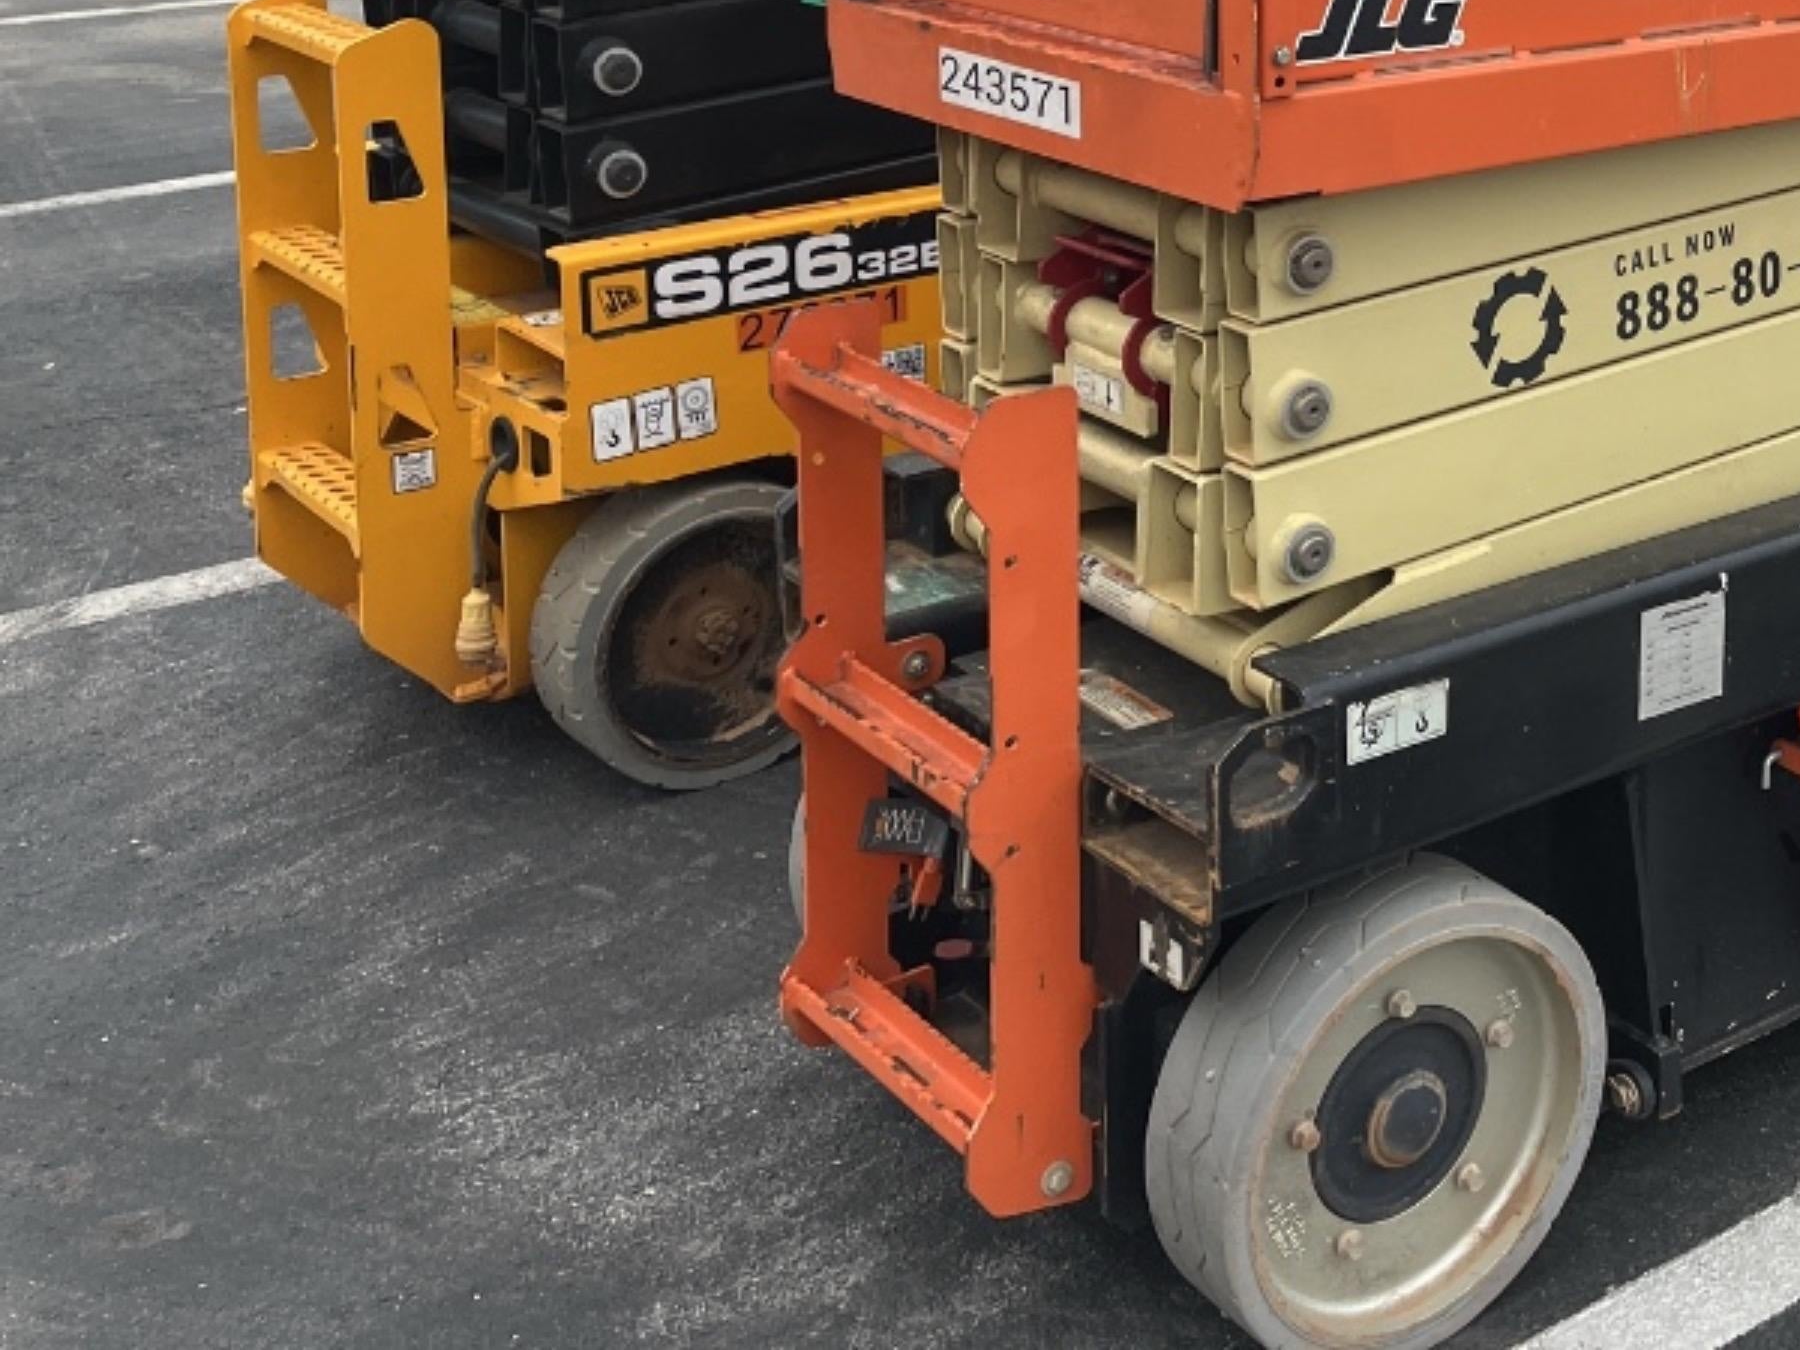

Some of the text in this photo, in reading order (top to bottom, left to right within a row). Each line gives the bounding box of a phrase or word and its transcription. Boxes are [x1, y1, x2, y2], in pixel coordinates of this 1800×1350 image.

[940, 54, 1074, 126] 243571
[1614, 222, 1737, 278] CALL NOW
